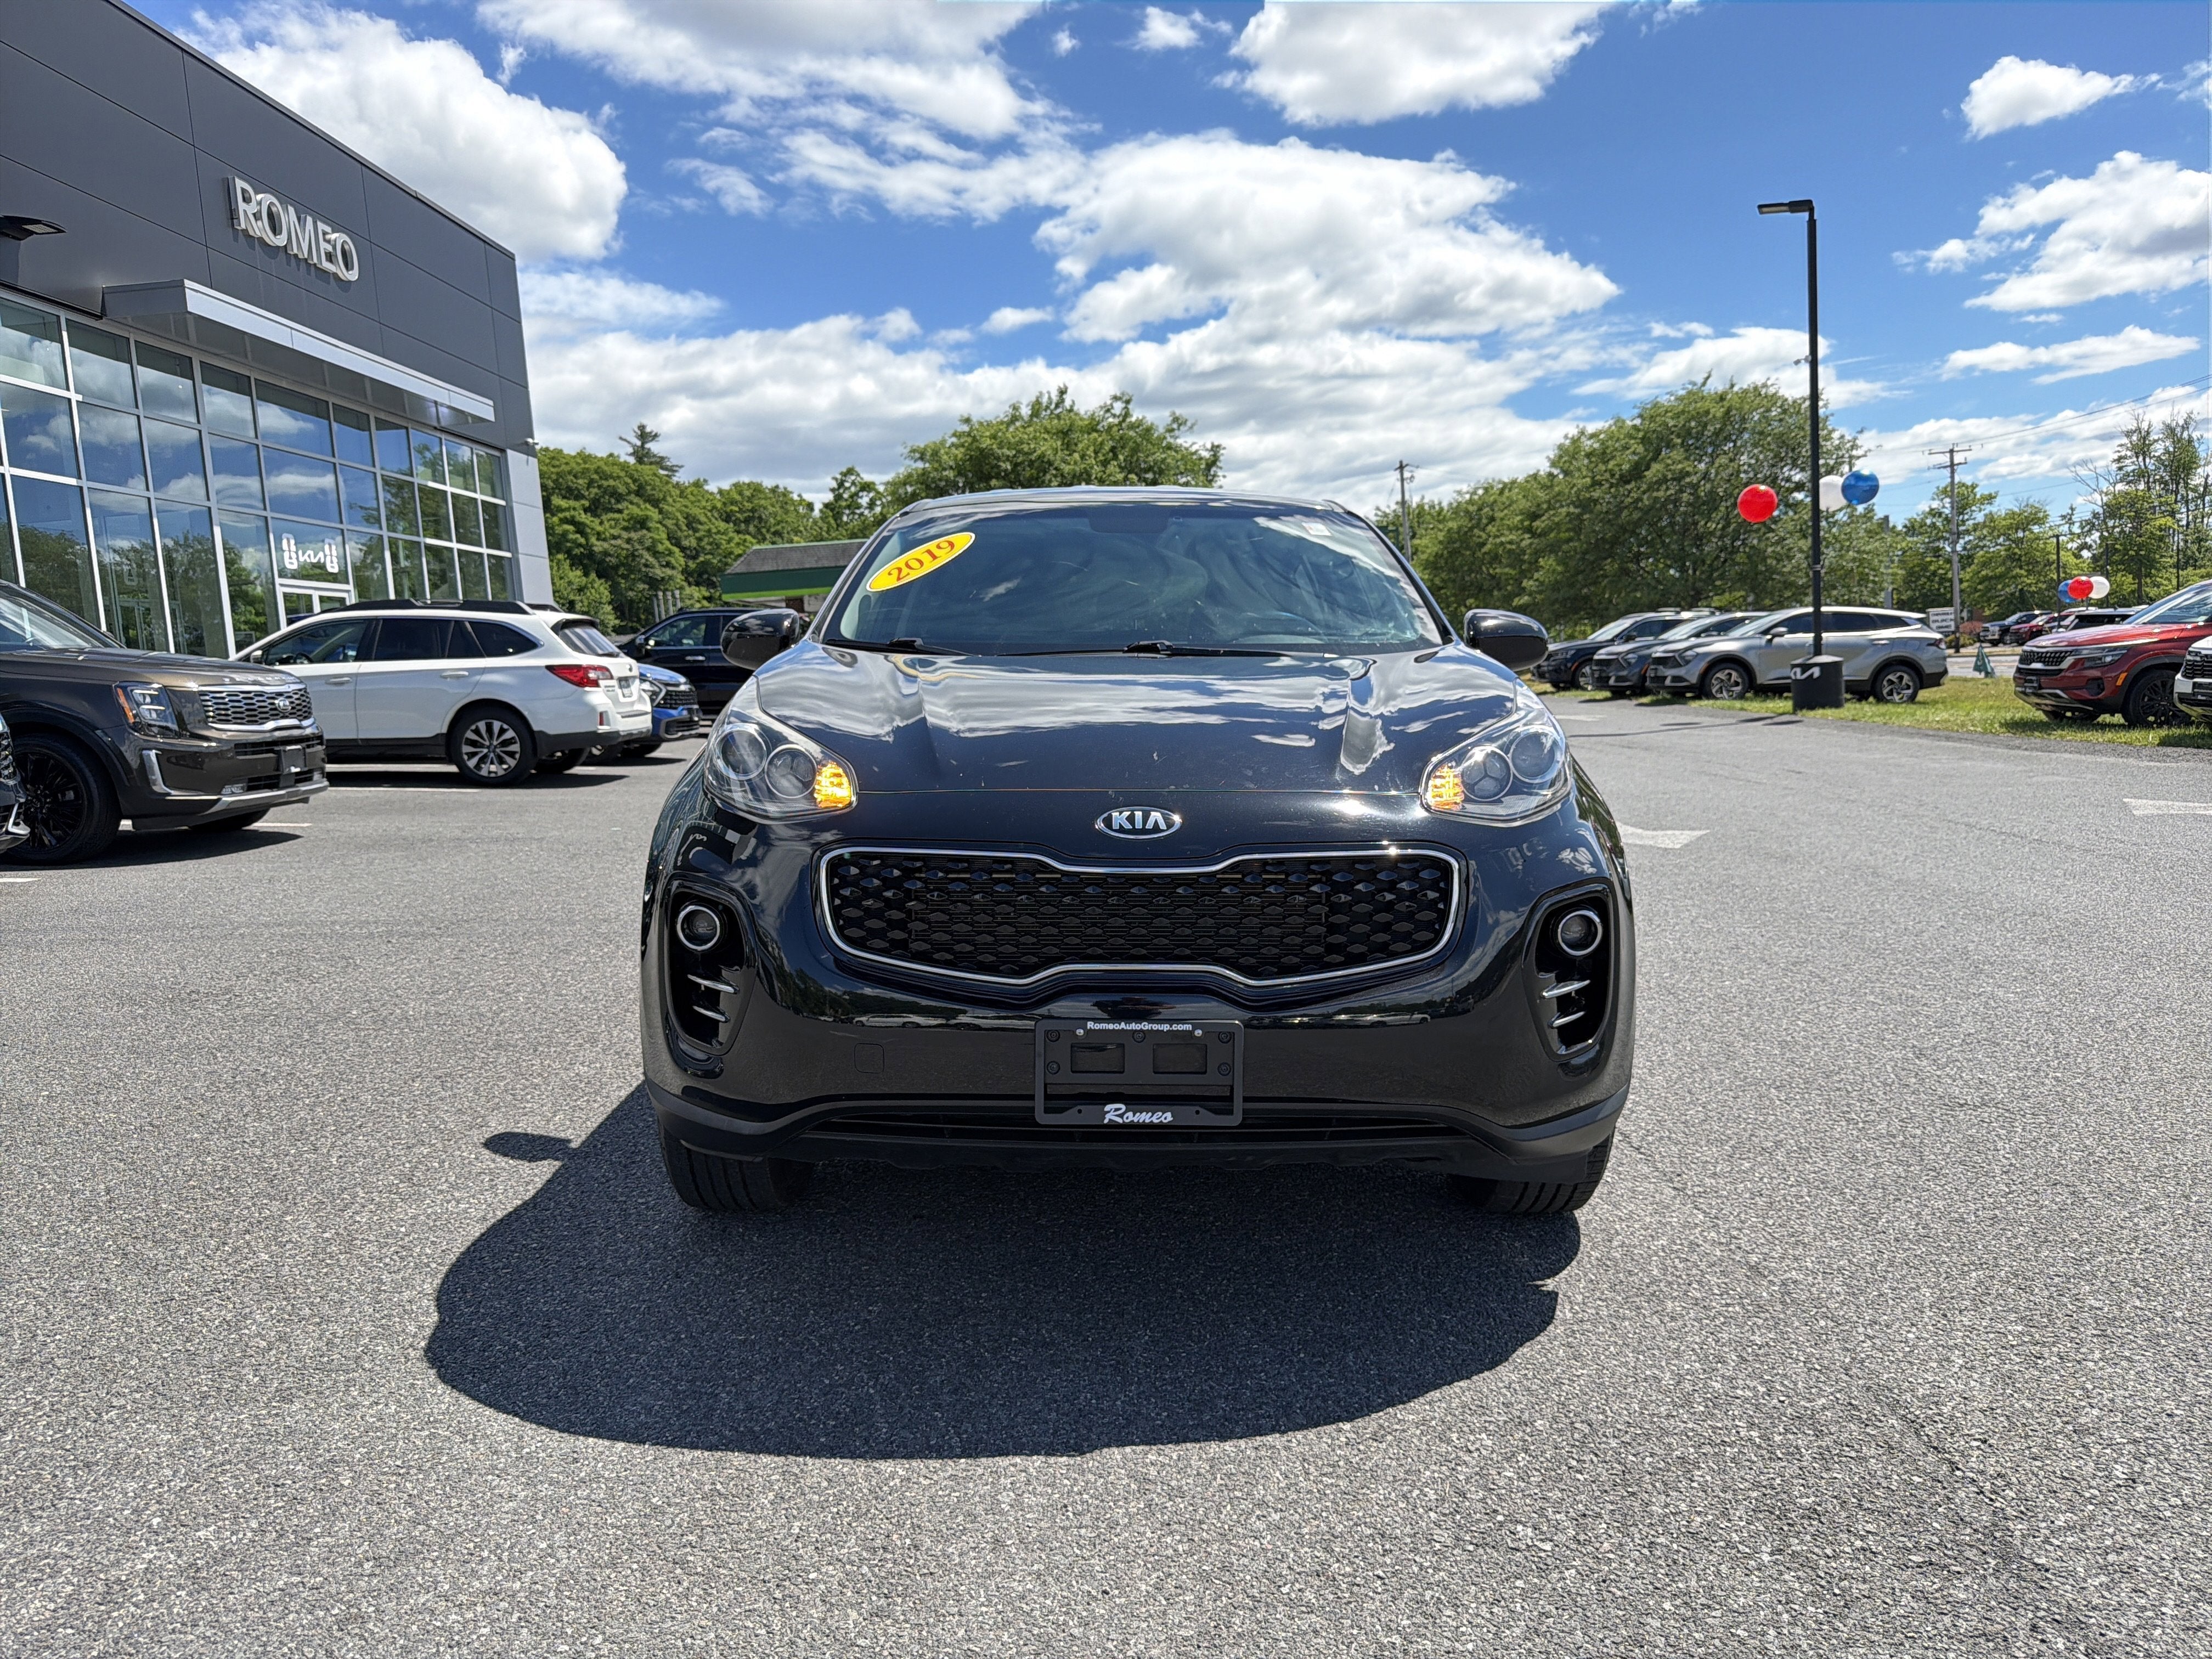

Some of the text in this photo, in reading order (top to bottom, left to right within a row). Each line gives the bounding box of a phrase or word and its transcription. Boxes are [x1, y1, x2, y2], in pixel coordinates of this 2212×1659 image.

[228, 176, 359, 281] ROMEO
[887, 540, 955, 582] 2019
[1111, 811, 1167, 830] KIA
[1087, 1021, 1192, 1031] RomeoAutoGroup.com
[1103, 1103, 1173, 1124] Romeo
